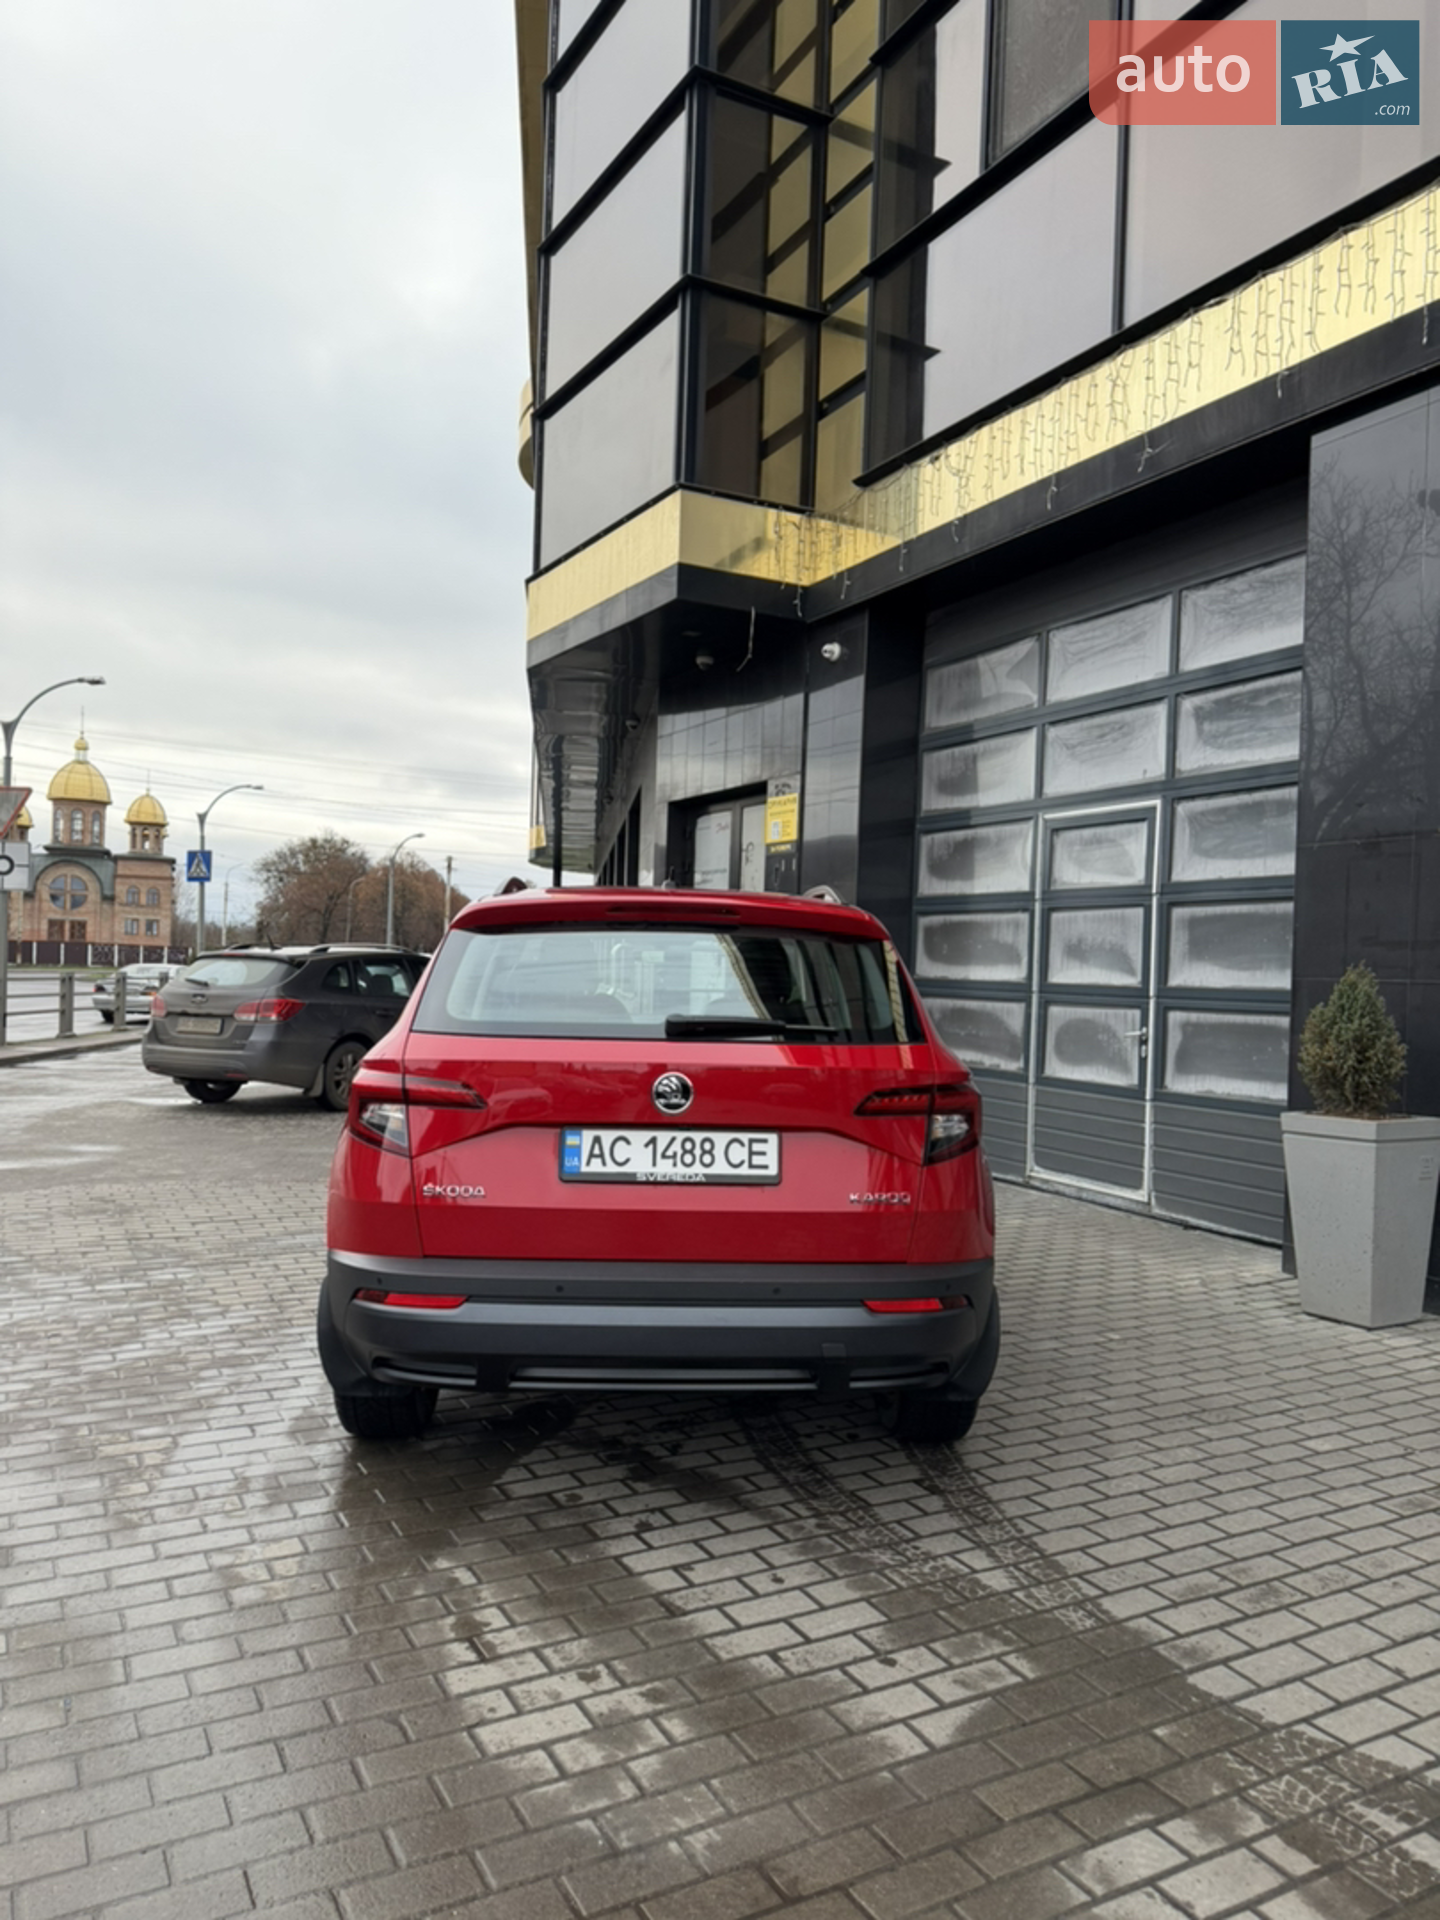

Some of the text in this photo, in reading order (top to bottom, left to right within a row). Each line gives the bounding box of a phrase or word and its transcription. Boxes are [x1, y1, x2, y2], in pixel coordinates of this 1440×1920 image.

[565, 1156, 579, 1167] UA
[585, 1134, 769, 1169] AC 1488 CE
